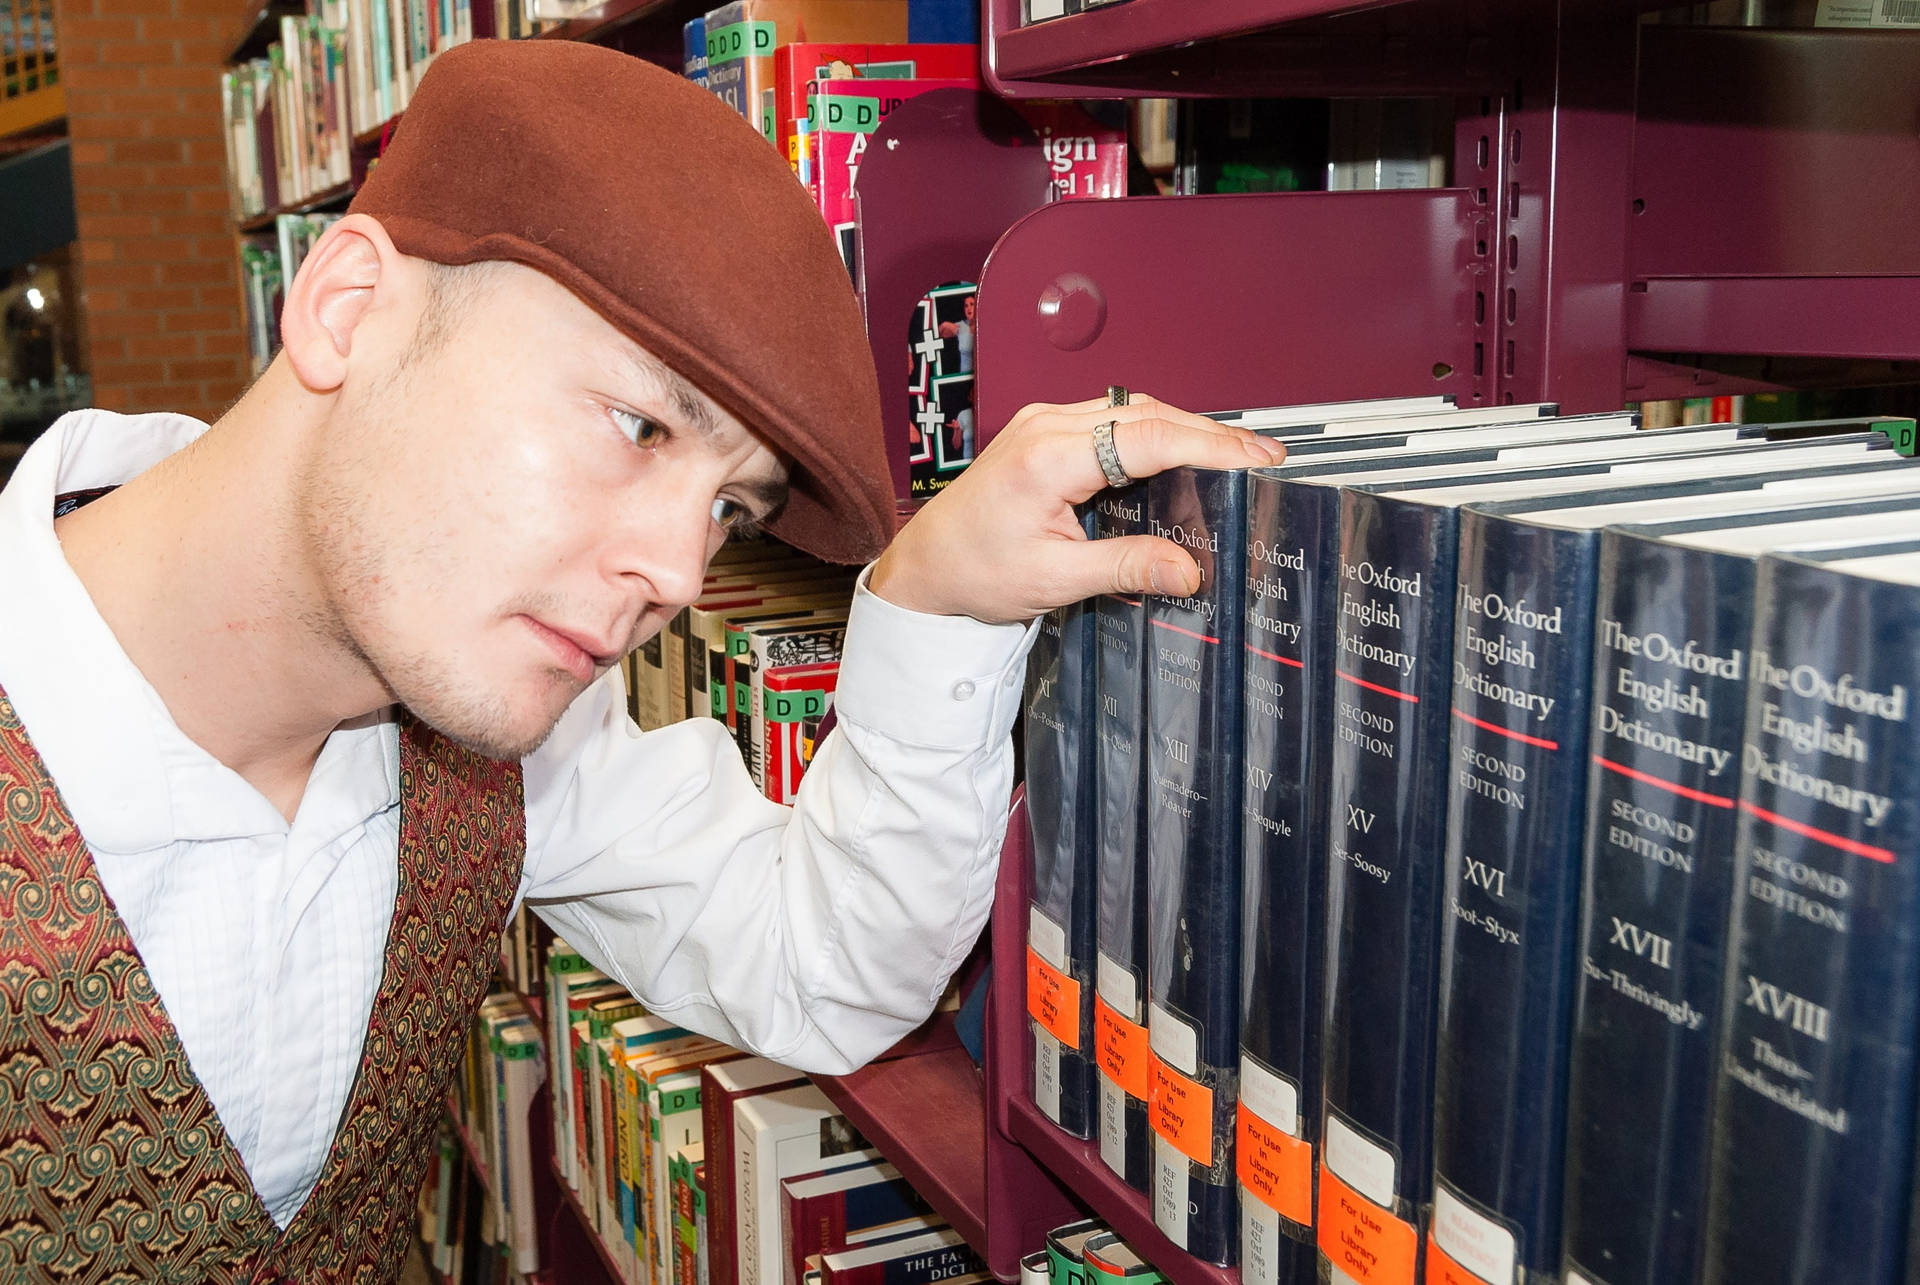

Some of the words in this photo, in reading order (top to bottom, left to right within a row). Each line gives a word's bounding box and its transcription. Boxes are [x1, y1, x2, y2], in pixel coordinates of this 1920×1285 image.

[755, 29, 769, 48] D
[829, 104, 843, 123] D
[857, 105, 872, 124] D
[1043, 126, 1097, 173] ign
[1084, 173, 1094, 194] 1
[1900, 429, 1912, 447] D
[912, 479, 926, 491] M.
[1103, 500, 1141, 522] Oxford
[1150, 520, 1172, 540] The
[1172, 525, 1218, 553] Oxford
[1253, 540, 1305, 571] Oxford
[1358, 561, 1421, 597] Oxford
[1343, 592, 1401, 630] English
[1458, 583, 1482, 614] The
[1483, 593, 1562, 635] Oxford
[1248, 609, 1302, 644] ctionary
[736, 639, 749, 654] D
[1159, 648, 1201, 672] SECOND
[1336, 625, 1416, 677] Dictionary
[1465, 625, 1536, 669] English
[1602, 619, 1642, 656] The
[1642, 633, 1742, 680] Oxford
[1039, 677, 1051, 698] XI
[1159, 670, 1201, 694] EDITION
[1453, 661, 1555, 721] Dictionary
[1617, 667, 1709, 719] English
[1751, 650, 1790, 691] The
[1790, 664, 1906, 722] Oxford
[738, 689, 745, 706] D
[777, 699, 791, 716] D
[805, 697, 818, 714] D
[1103, 694, 1117, 718] XII
[1247, 693, 1284, 720] DITION
[1340, 702, 1394, 734] SECOND
[1761, 701, 1867, 763] English
[1165, 736, 1189, 765] XIII
[1339, 724, 1394, 758] EDITION
[1600, 705, 1732, 777] Dictionary
[1247, 763, 1273, 792] XIV
[1462, 745, 1526, 782] SECOND
[1459, 771, 1525, 810] EDITION
[1743, 742, 1891, 828] Dictionary
[1161, 794, 1192, 818] Roaver
[1347, 804, 1376, 834] XV
[1611, 799, 1695, 844] SECOND
[1609, 825, 1693, 873] EDITION
[1464, 856, 1506, 898] XVI
[1752, 848, 1849, 899] SECOND
[1750, 875, 1847, 933] EDITION
[1610, 916, 1673, 970] XVII
[1039, 967, 1048, 979] For
[1039, 995, 1058, 1016] Library
[1745, 975, 1829, 1042] XVIII
[1103, 1015, 1112, 1027] For
[1114, 1022, 1127, 1039] Use
[1104, 1043, 1125, 1067] Library
[1157, 1071, 1169, 1086] For
[1171, 1082, 1187, 1098] Use
[673, 1095, 685, 1108] D
[1158, 1104, 1185, 1127] Library
[1161, 1118, 1180, 1139] Only.
[1248, 1124, 1261, 1140] For
[1263, 1136, 1282, 1154] Use
[1249, 1155, 1279, 1185] Library
[1253, 1174, 1275, 1197] Only.
[1340, 1198, 1358, 1218] For
[1360, 1212, 1382, 1234] Use
[1341, 1230, 1378, 1267] Library
[905, 1256, 934, 1272] THE
[931, 1263, 965, 1280] DICT
[1345, 1251, 1371, 1279] Only.
